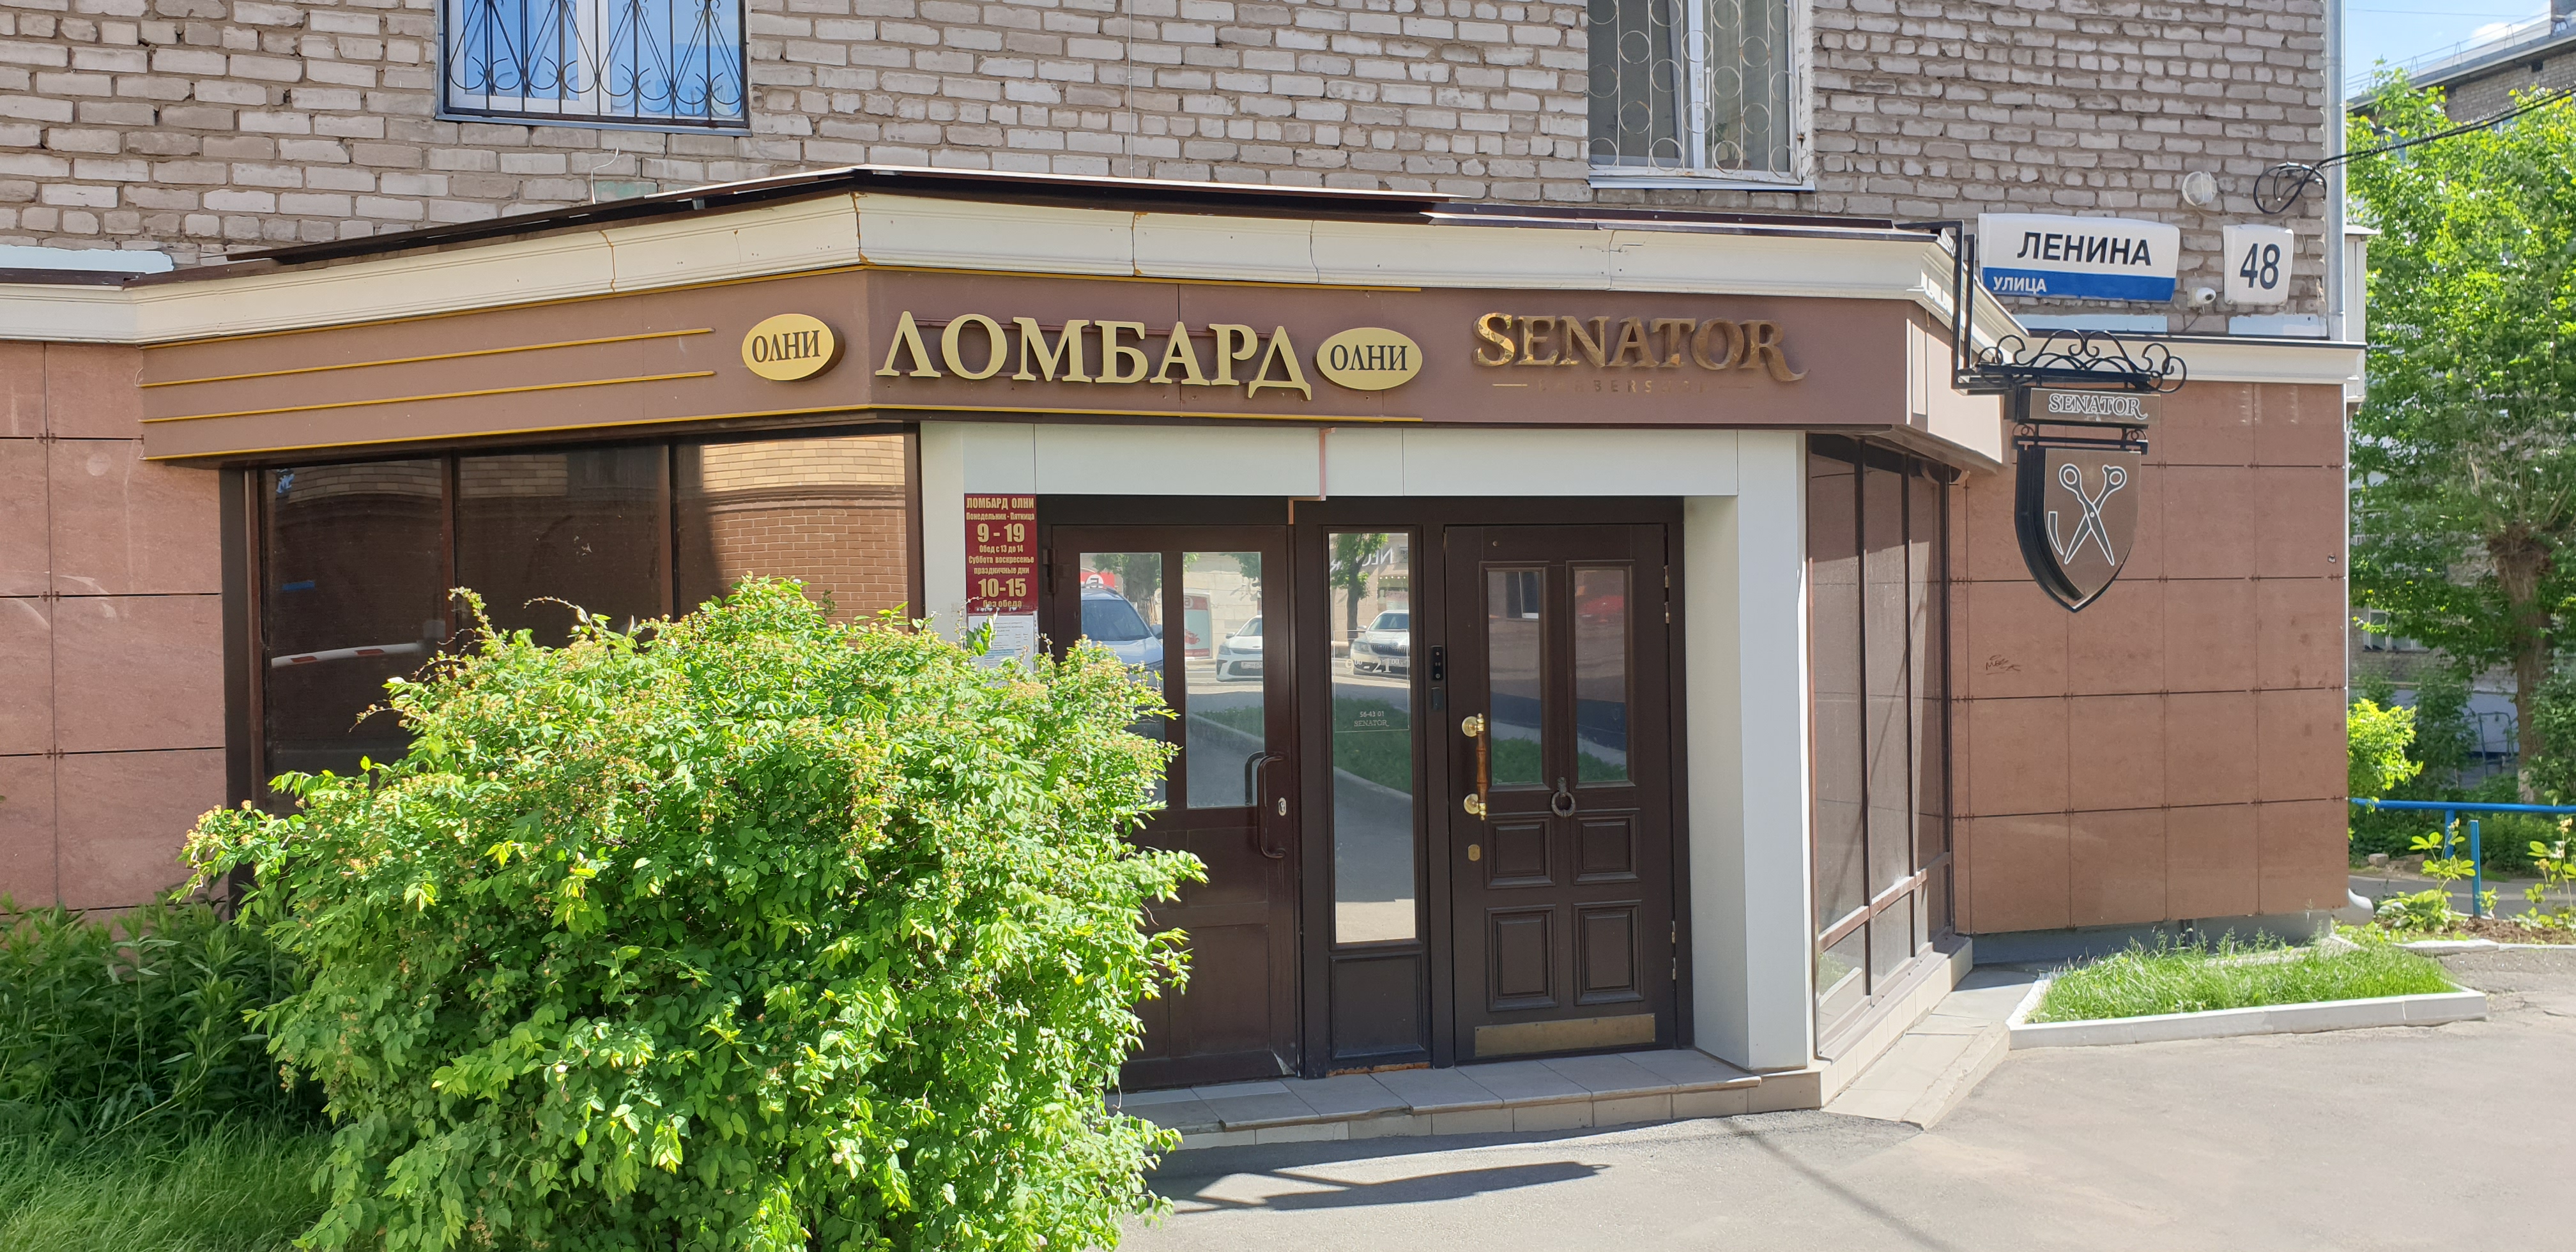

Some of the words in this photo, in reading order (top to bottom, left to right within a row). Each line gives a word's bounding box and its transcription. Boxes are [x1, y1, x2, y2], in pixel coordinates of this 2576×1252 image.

[2017, 231, 2152, 267] ЛЕНИНА
[2240, 242, 2280, 290] 48
[1992, 275, 2047, 294] УЛИЦА
[752, 330, 821, 362] ОЛНИ
[875, 310, 1312, 401] ЛОМБАРД
[1472, 312, 1812, 383] SENATOR
[1330, 344, 1408, 372] ОЛНИ
[2048, 393, 2148, 420] SENATOR
[966, 498, 1008, 510] ЛОМБАРД
[1011, 498, 1034, 508] ОЛНИ
[966, 512, 1006, 521] Понедельник
[1010, 512, 1035, 521] Пятница
[977, 523, 989, 542] 9
[1004, 523, 1025, 542] 19
[969, 556, 993, 564] Суббота
[979, 545, 995, 554] Обед
[977, 578, 1027, 597] 10-15
